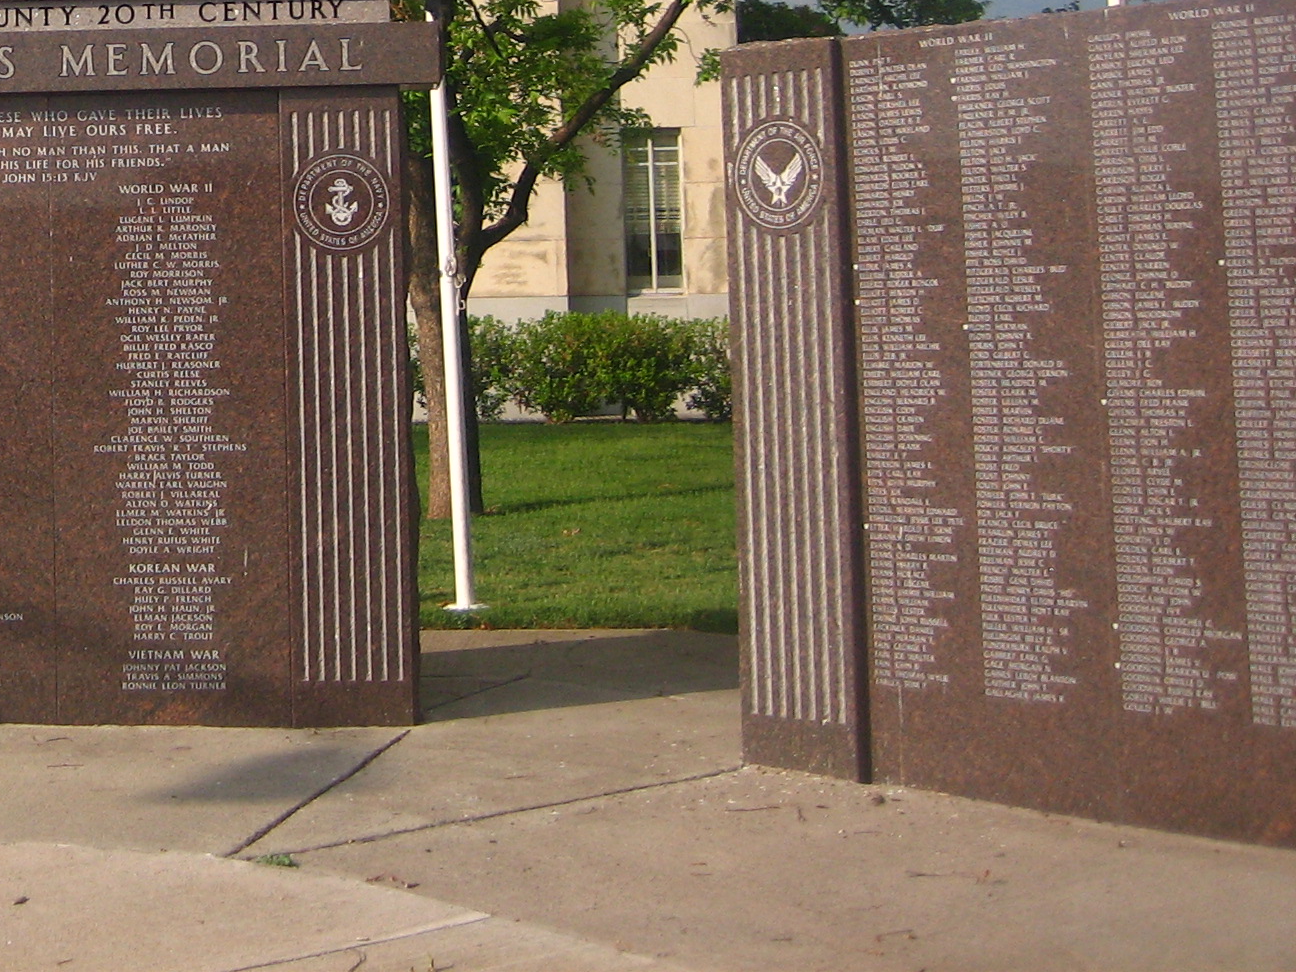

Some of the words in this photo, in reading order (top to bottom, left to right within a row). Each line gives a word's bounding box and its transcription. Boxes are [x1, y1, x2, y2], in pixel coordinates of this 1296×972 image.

[96, 3, 176, 25] 20TH
[1168, 8, 1209, 21] WORLD
[1213, 5, 1241, 16] WAR
[1245, 3, 1254, 13] II
[918, 36, 955, 48] WORLD
[958, 33, 981, 44] WAR
[984, 32, 993, 41] II
[58, 37, 364, 77] MEMORIAL
[30, 110, 69, 123] WHO
[76, 109, 116, 122] GAVE
[124, 108, 172, 120] THEIR
[180, 107, 224, 119] LIVES
[1, 126, 34, 138] MAY
[43, 125, 78, 138] LIVE
[85, 124, 127, 137] OURS
[135, 123, 178, 135] FREE.
[12, 146, 31, 157] NO
[36, 145, 65, 157] MAN
[71, 145, 106, 156] THAN
[148, 143, 181, 154] THAT
[186, 143, 195, 153] A
[200, 142, 230, 153] MAN
[0, 159, 20, 170] HIS
[25, 159, 49, 170] LIFE
[56, 158, 80, 169] FOR
[85, 157, 105, 168] HIS
[2, 172, 36, 184] JOHN
[74, 171, 98, 182] KJV
[118, 184, 164, 194] WORLD
[169, 184, 199, 193] WAR
[204, 183, 213, 193] II
[128, 563, 180, 573] KOREAN
[186, 563, 215, 573] WAR
[128, 650, 184, 660] VIETNAM
[190, 649, 220, 659] WAR
